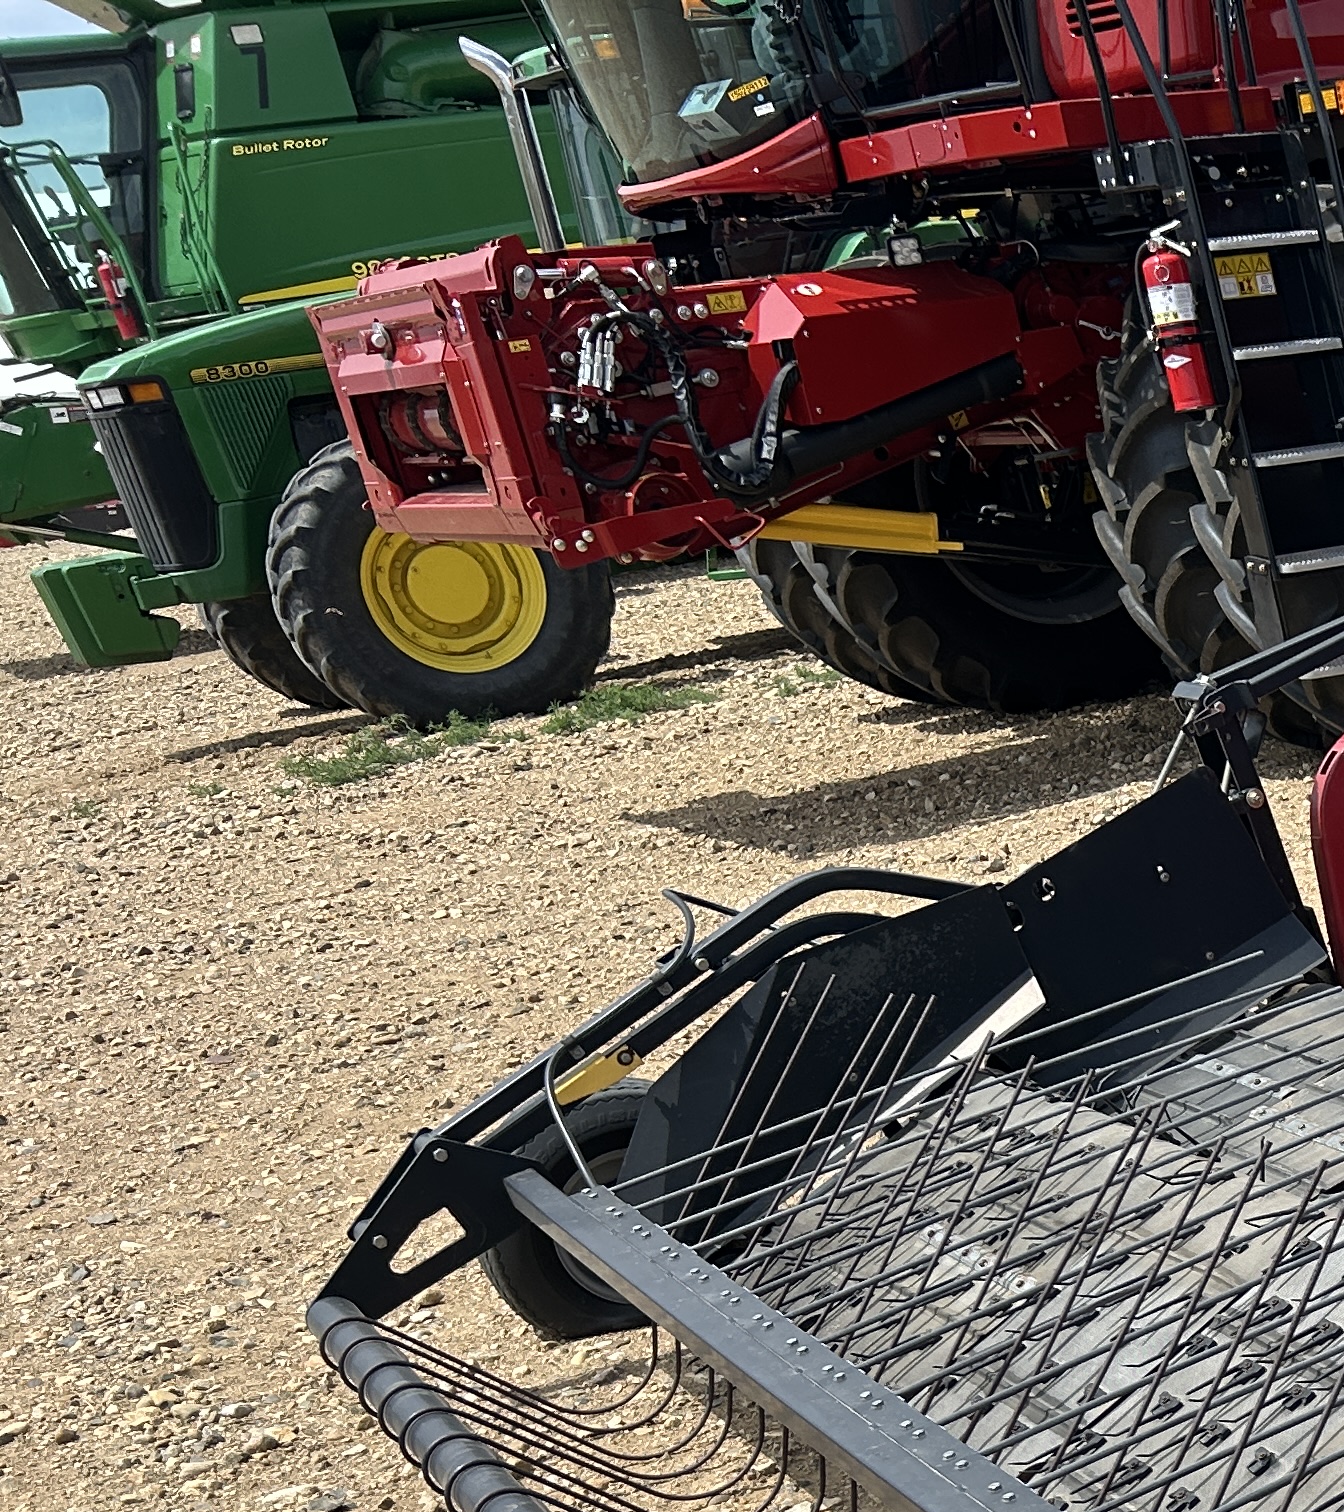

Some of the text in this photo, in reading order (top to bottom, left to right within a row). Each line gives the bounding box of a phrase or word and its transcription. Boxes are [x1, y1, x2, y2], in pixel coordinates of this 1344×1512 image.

[232, 137, 329, 156] Bullet Rotor
[206, 361, 270, 381] 8300
